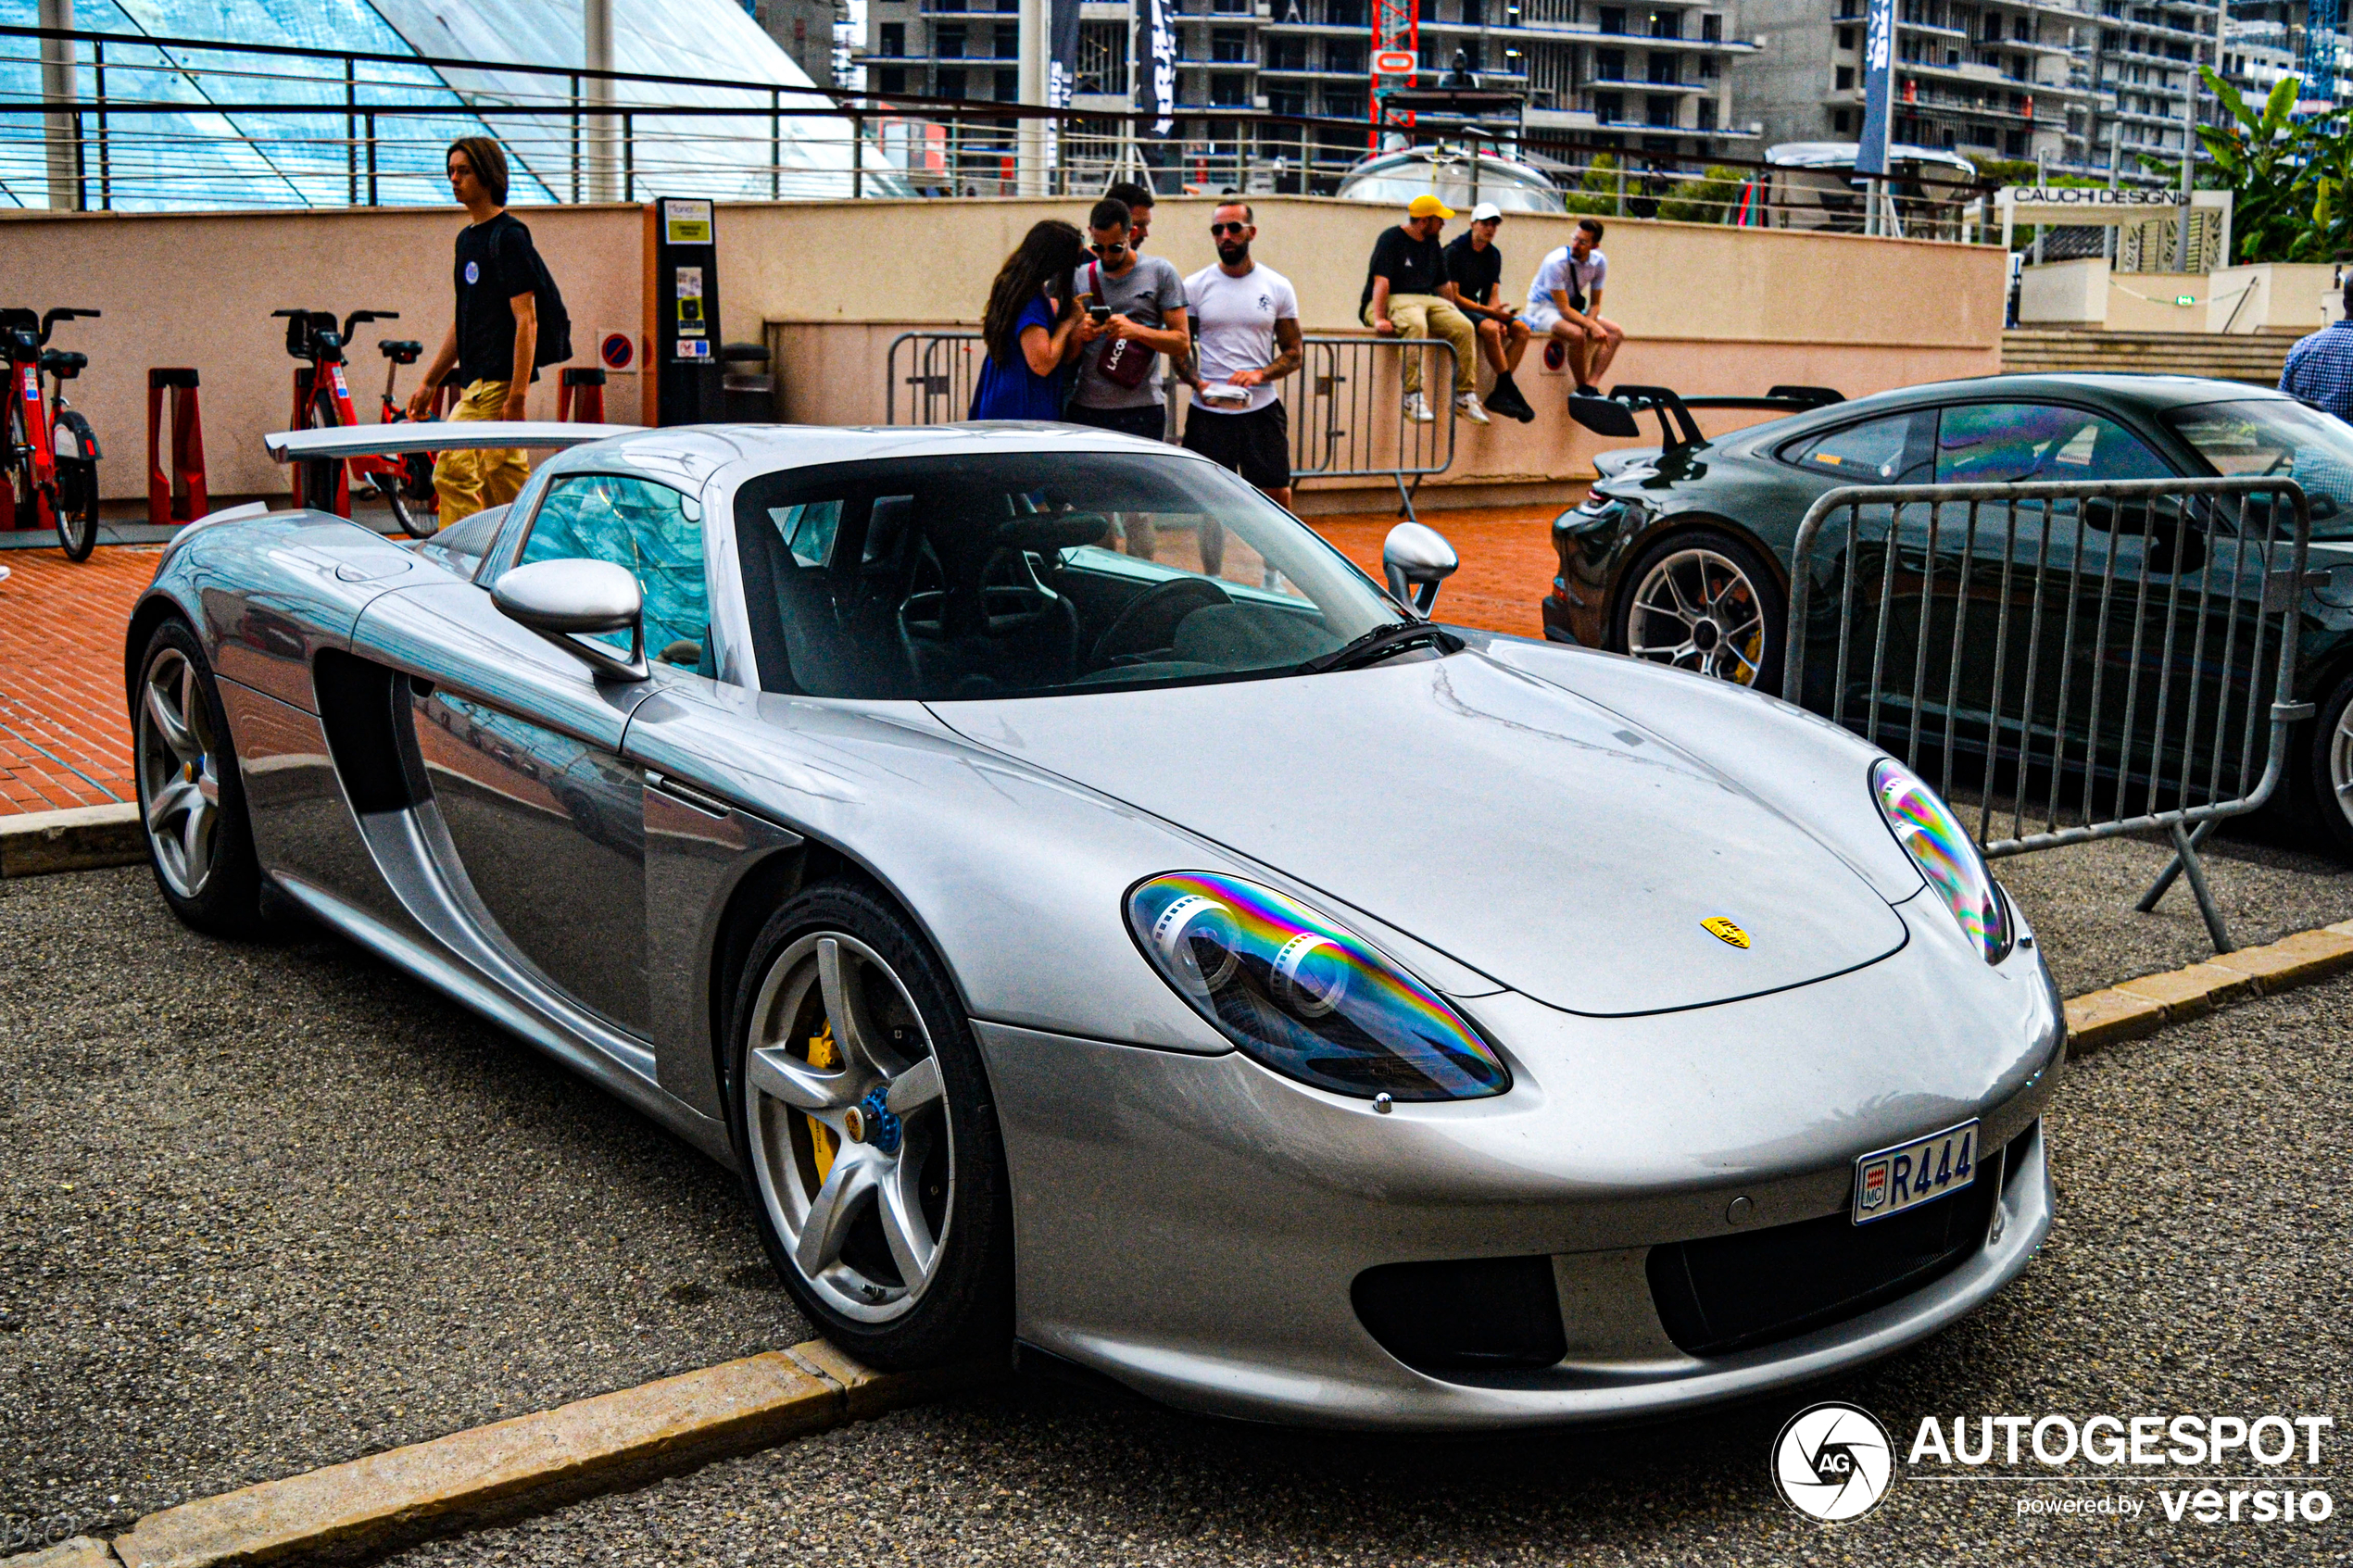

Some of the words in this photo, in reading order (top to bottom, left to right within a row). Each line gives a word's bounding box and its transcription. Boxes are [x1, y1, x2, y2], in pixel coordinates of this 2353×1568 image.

[2014, 188, 2095, 203] CAUCHI
[2099, 189, 2177, 205] DESIGN
[1891, 1131, 1971, 1206] R444
[1866, 1187, 1882, 1204] MC
